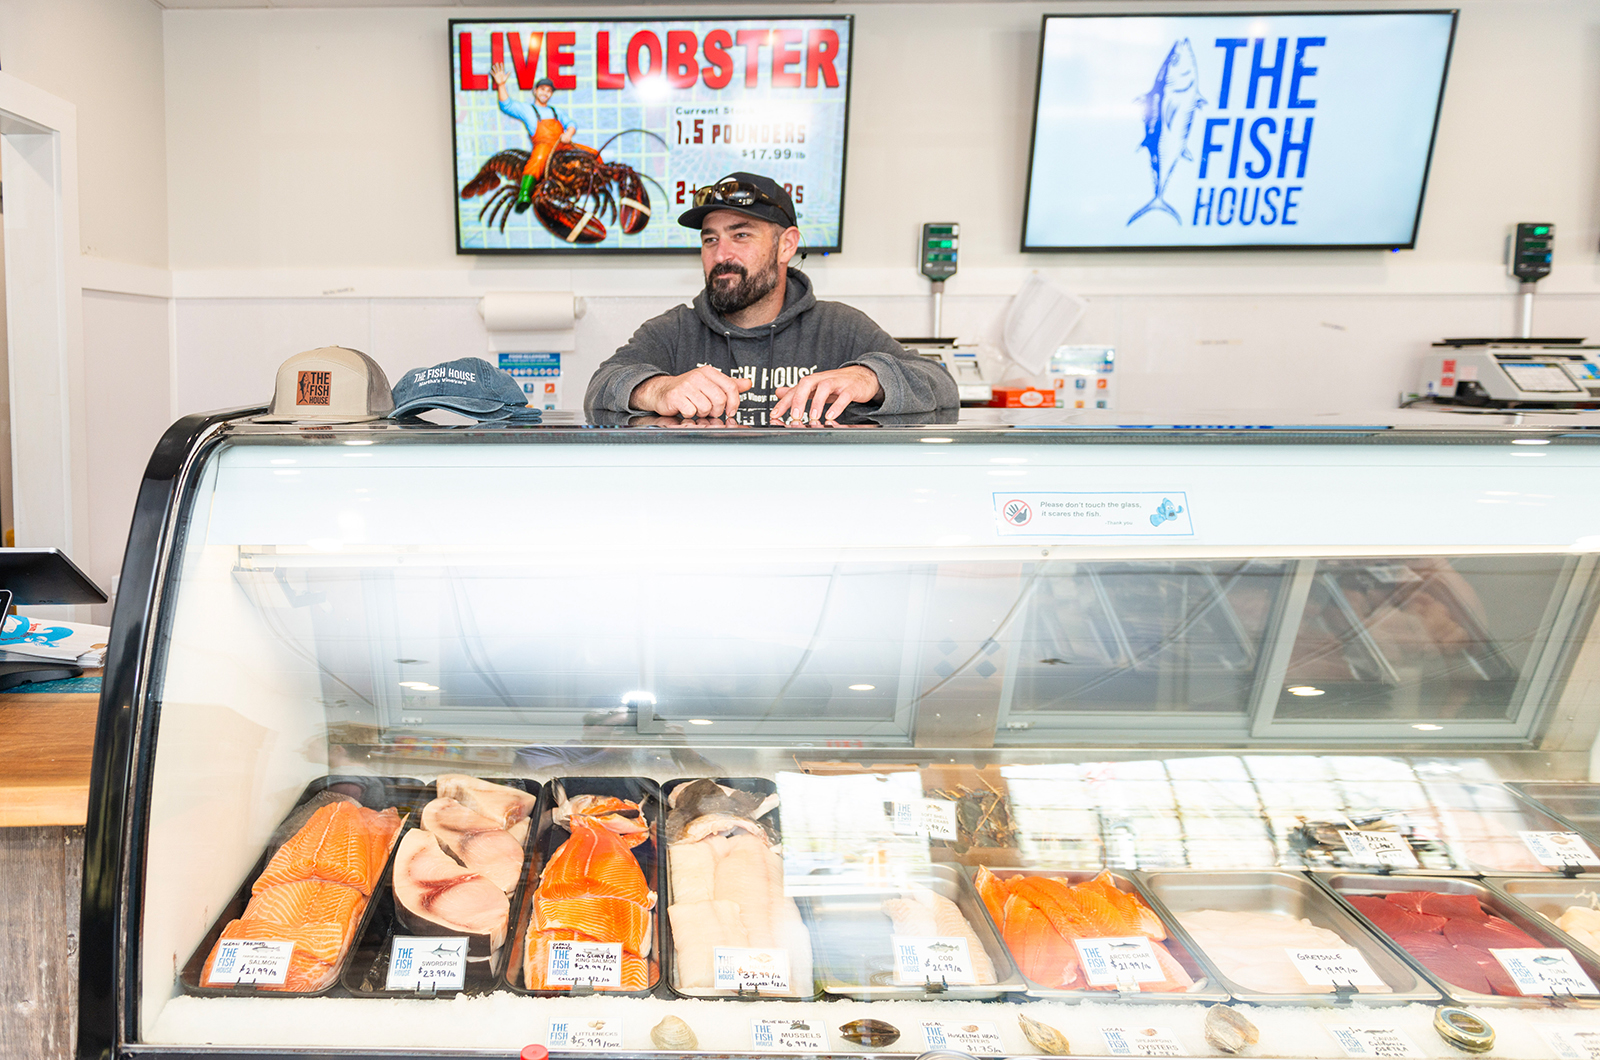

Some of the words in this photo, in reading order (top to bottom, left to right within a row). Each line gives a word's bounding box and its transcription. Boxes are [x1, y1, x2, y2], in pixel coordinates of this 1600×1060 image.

[458, 31, 576, 91] LIVE
[596, 28, 840, 90] LOBSTER
[1214, 36, 1327, 110] THE
[676, 107, 718, 115] Current
[677, 118, 704, 144] 1.5
[712, 122, 805, 144] POUNDERS
[1198, 116, 1314, 180] FISH
[1192, 186, 1304, 227] HOUSE
[311, 372, 330, 384] THE
[414, 371, 426, 383] THE
[427, 367, 445, 380] FISH
[449, 368, 476, 382] HOUSE
[442, 377, 466, 385] Vineyard
[310, 385, 329, 396] FISH
[309, 396, 328, 404] HOUSE
[222, 948, 238, 958] THE
[398, 948, 414, 958] THE
[899, 945, 916, 955] THE
[1083, 948, 1102, 958] THE
[554, 950, 570, 960] THE
[218, 958, 236, 967] FISH
[395, 959, 412, 969] FISH
[552, 960, 569, 969] FISH
[718, 956, 734, 965] THE
[901, 956, 919, 965] FISH
[1087, 958, 1106, 968] FISH
[1506, 958, 1525, 968] THE
[1511, 968, 1533, 977] FISH
[552, 1023, 569, 1032] THE
[754, 1025, 771, 1033] THE
[925, 1027, 943, 1036] THE
[550, 1032, 568, 1040] FISH
[755, 1033, 773, 1041] FISH
[1103, 1032, 1124, 1040] THE
[1333, 1030, 1356, 1039] THE
[927, 1036, 946, 1044] FISH
[1108, 1040, 1128, 1048] FISH
[1340, 1039, 1362, 1047] FISH
